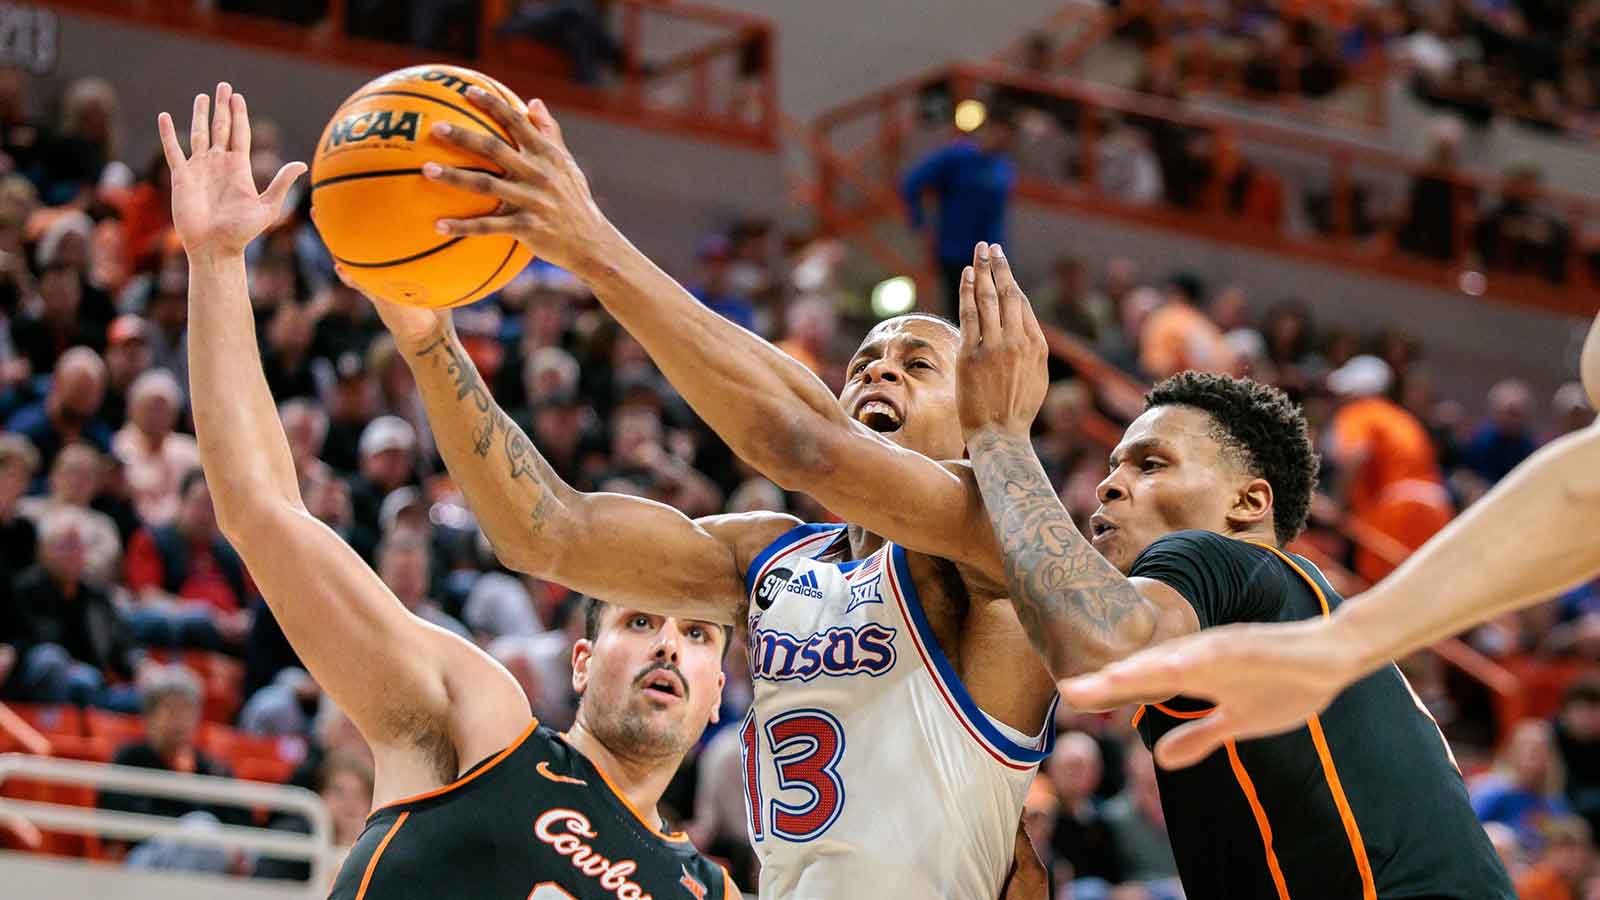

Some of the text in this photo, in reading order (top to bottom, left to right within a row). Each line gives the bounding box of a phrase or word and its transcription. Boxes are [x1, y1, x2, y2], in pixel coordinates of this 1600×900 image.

[325, 111, 420, 148] NCAA
[786, 583, 823, 600] adidas
[750, 620, 897, 682] ansas
[739, 706, 846, 843] 13
[534, 808, 653, 900] Cowbo
